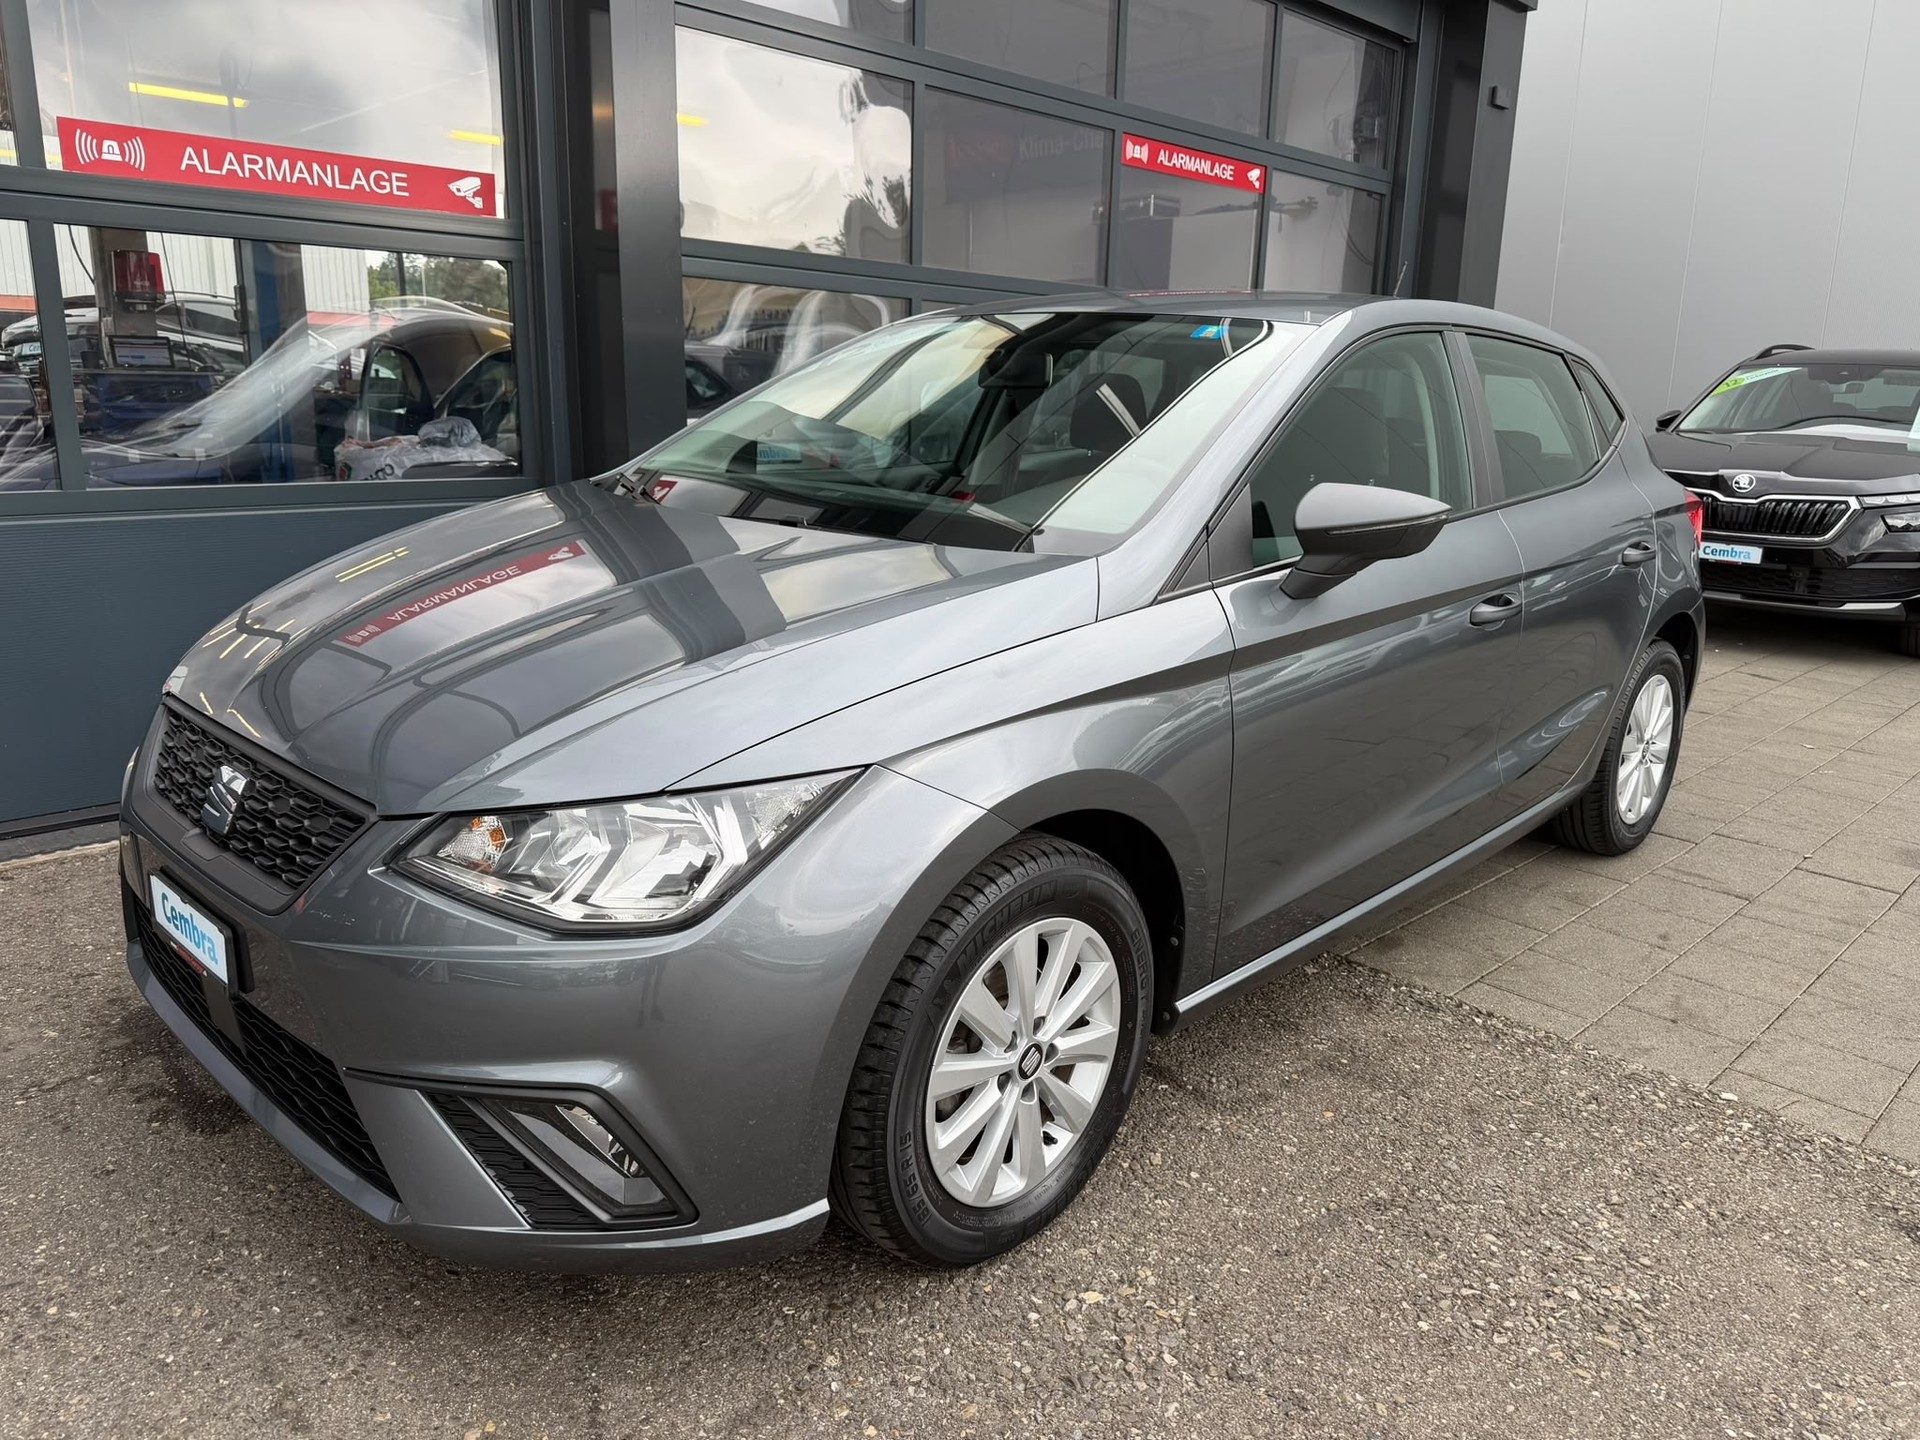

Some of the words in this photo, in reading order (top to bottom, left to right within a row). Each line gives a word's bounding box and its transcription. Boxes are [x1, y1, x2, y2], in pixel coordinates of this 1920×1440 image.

[180, 146, 410, 197] ALARMANLAGE
[1157, 149, 1235, 181] ALARMANLAGE
[1702, 545, 1751, 560] Cembra
[161, 892, 219, 966] Cembra
